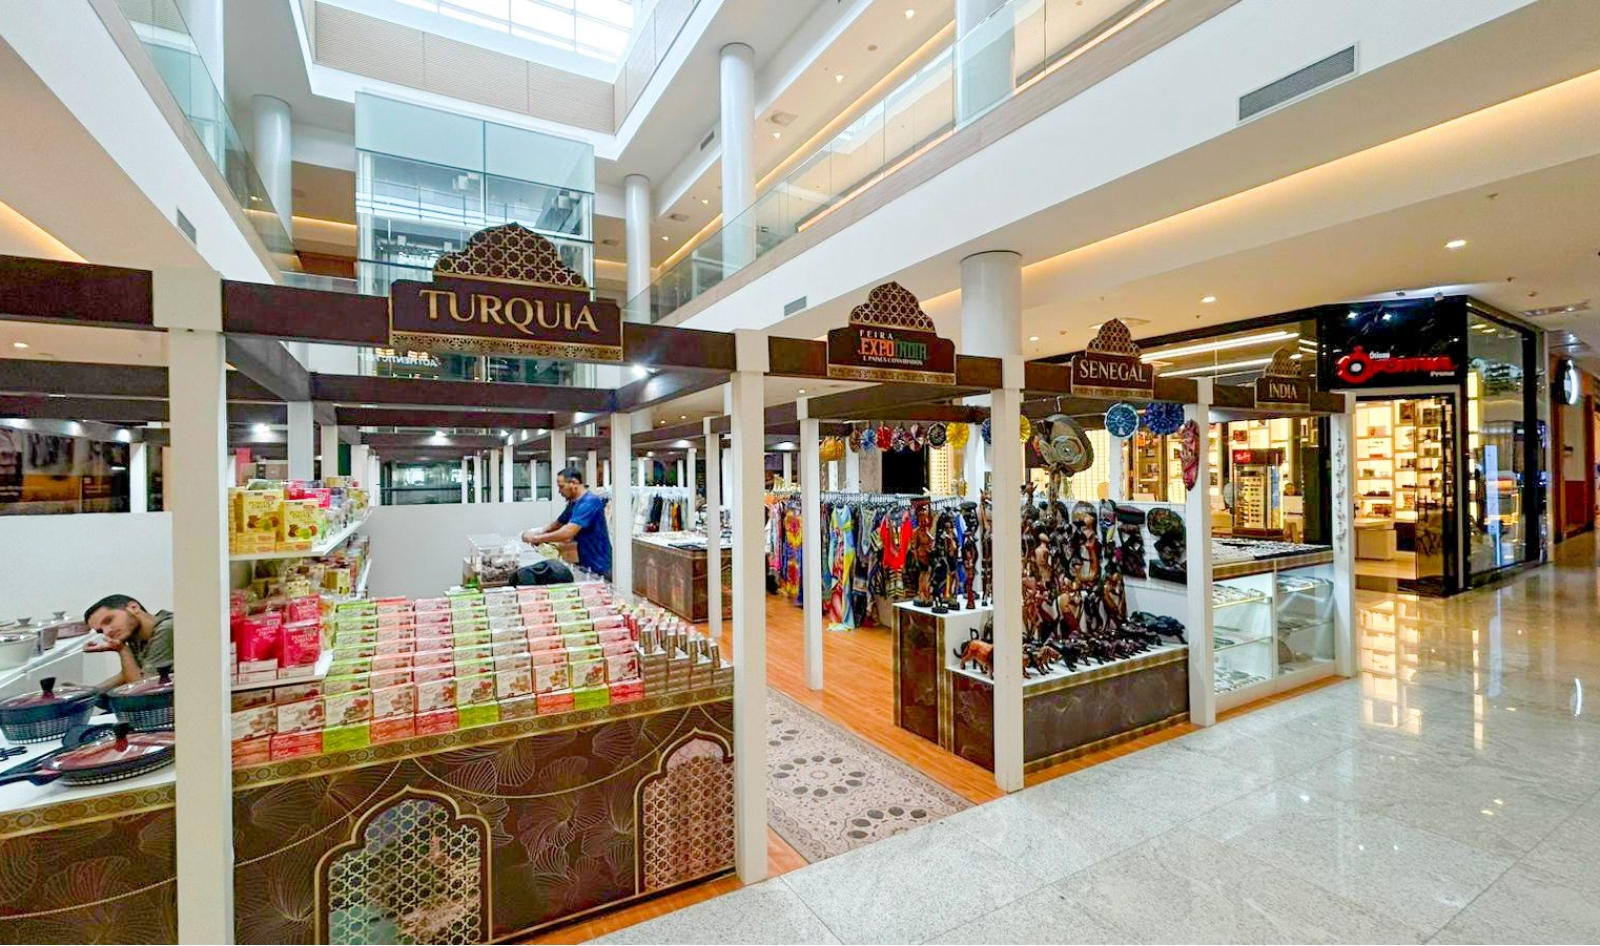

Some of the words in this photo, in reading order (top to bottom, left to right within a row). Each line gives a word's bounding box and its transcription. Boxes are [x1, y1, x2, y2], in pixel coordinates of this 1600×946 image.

[419, 289, 600, 335] TURQUIA
[859, 329, 894, 340] FEIRA
[1079, 359, 1147, 382] SENEGAL
